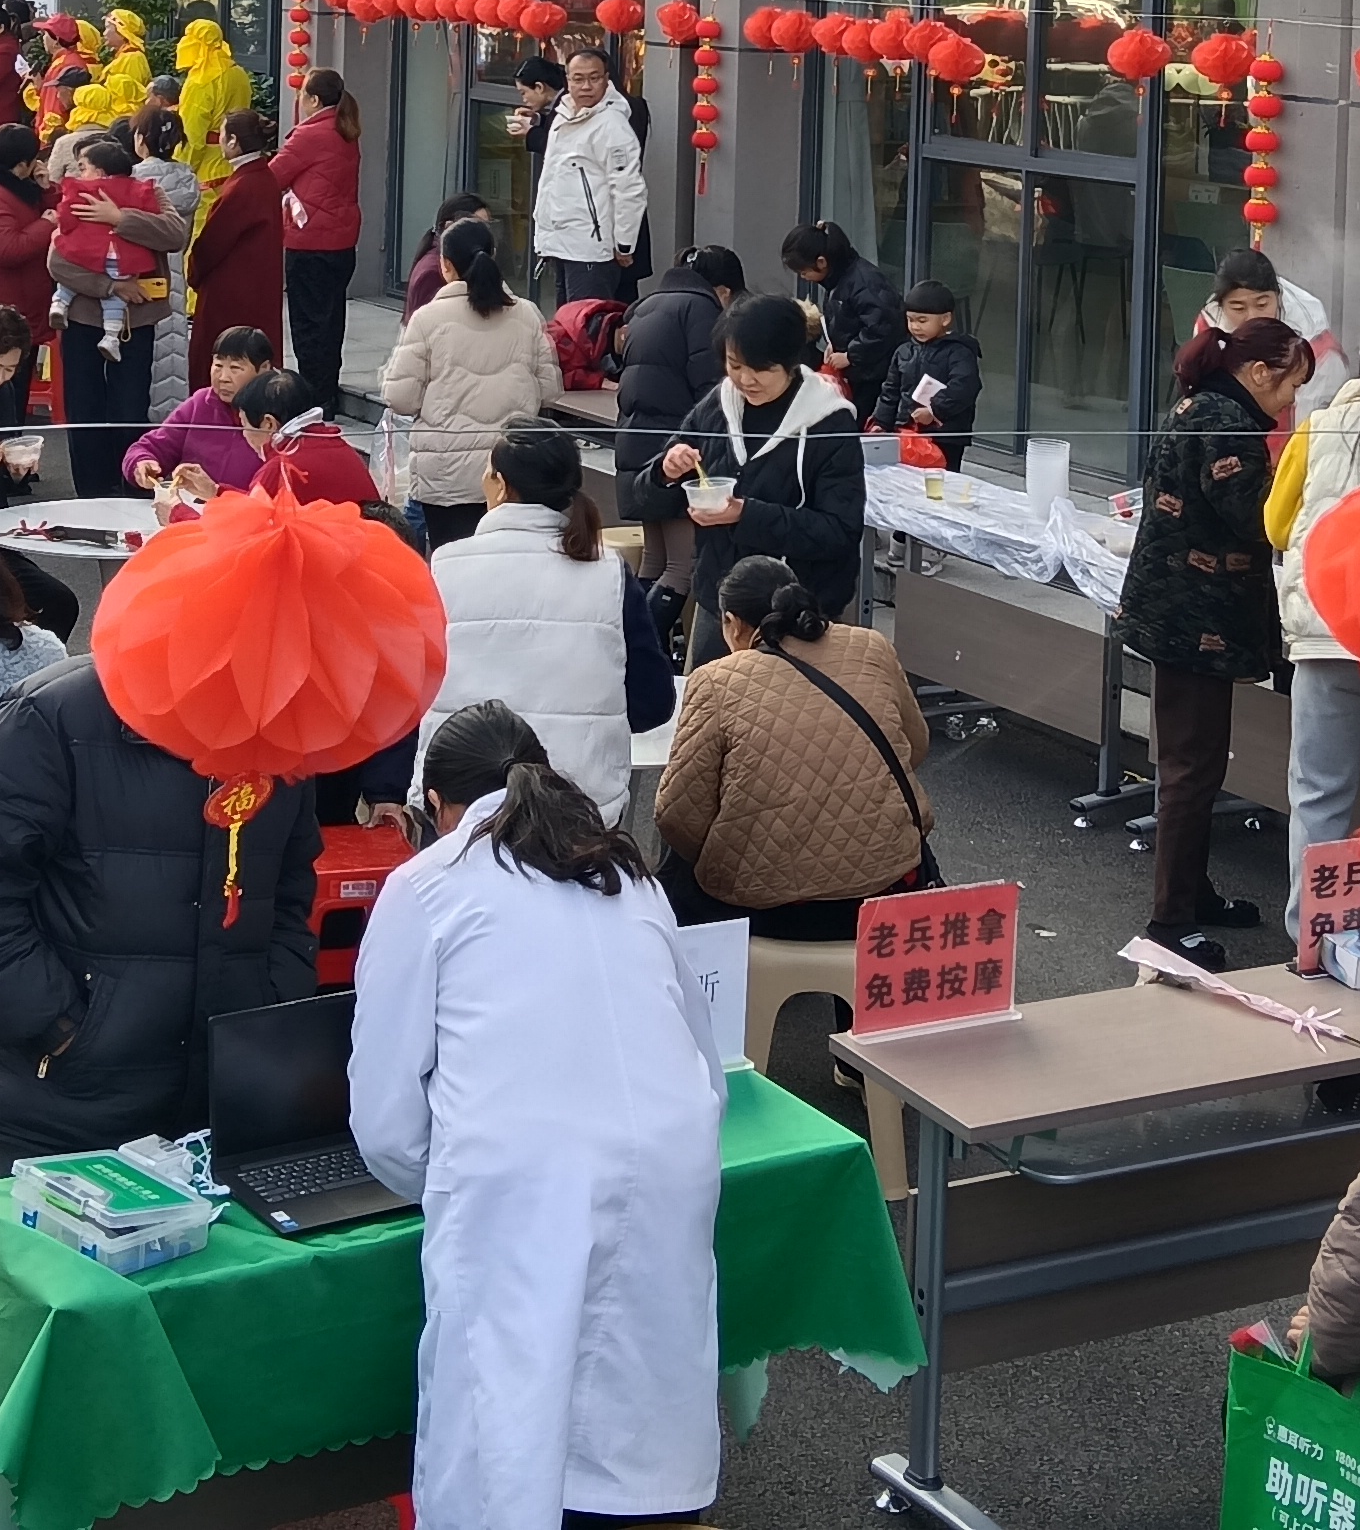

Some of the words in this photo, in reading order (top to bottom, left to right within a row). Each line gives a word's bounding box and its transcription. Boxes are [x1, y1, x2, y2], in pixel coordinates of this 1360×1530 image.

[220, 782, 256, 816] 福
[867, 907, 1008, 960] 老兵推拿
[864, 956, 1004, 1011] 免费按摩
[1265, 1456, 1356, 1530] 助听器
